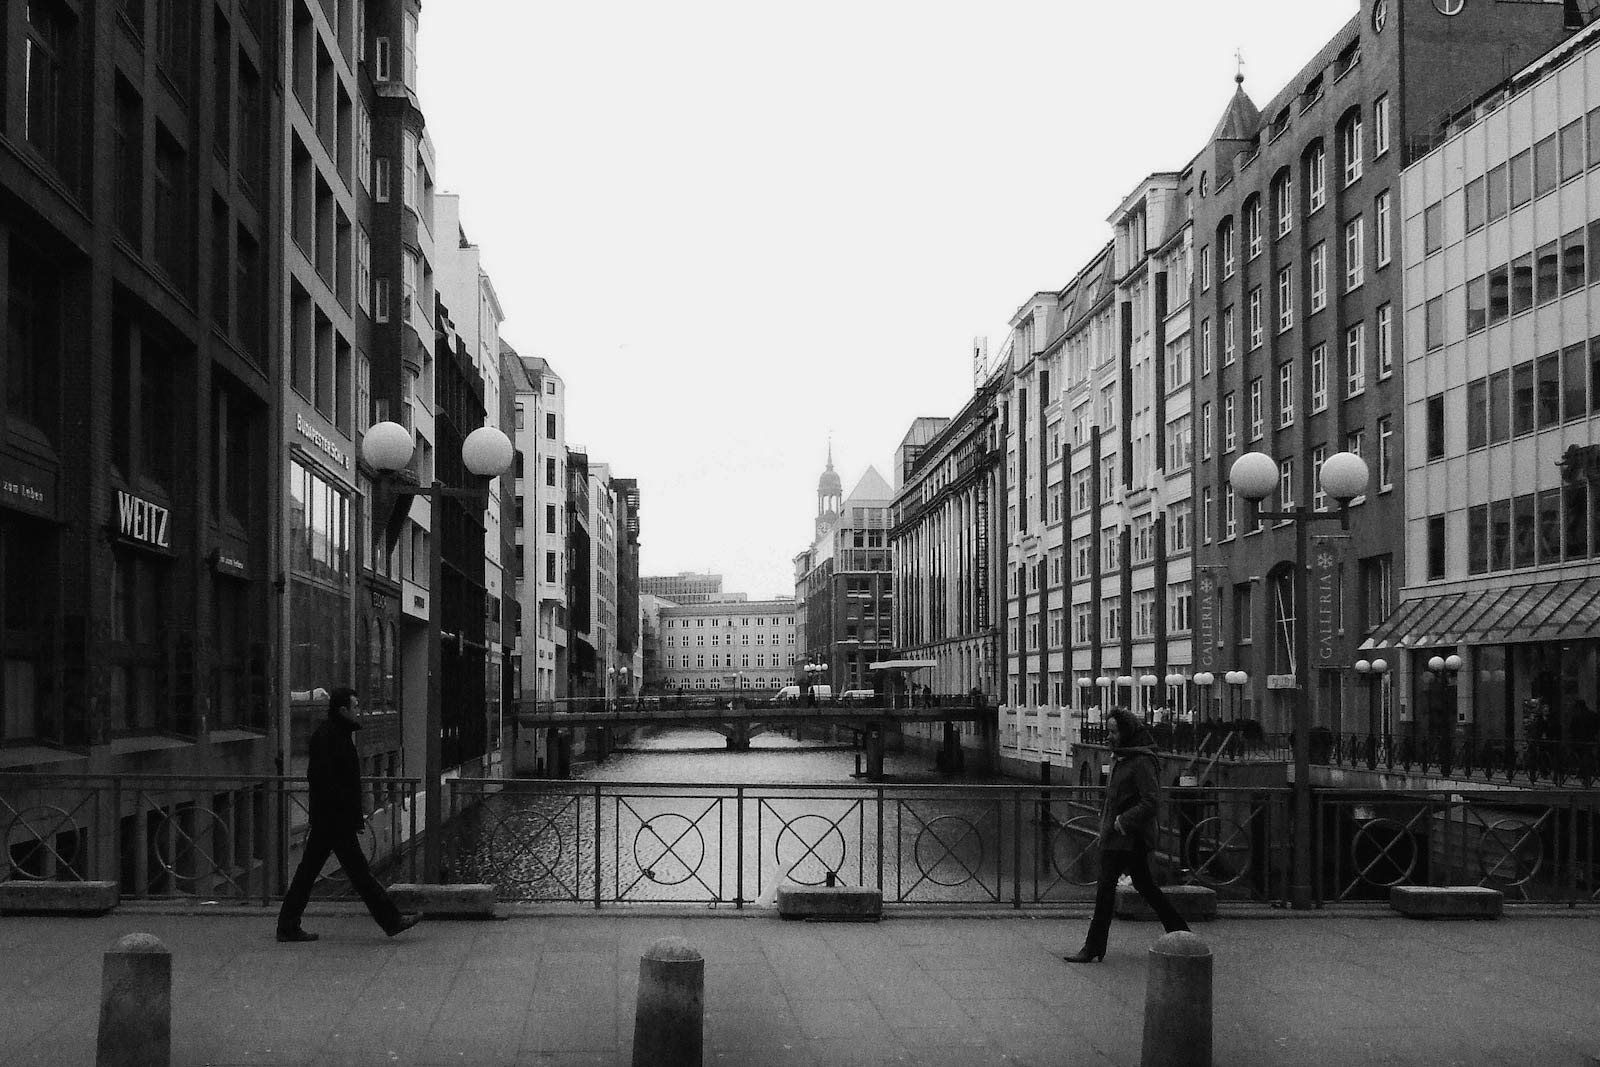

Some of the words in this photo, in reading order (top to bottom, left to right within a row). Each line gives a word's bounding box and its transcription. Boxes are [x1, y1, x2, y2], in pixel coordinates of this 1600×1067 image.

[117, 490, 169, 548] WEITZ
[1201, 595, 1213, 666] GALLERIA
[1319, 574, 1333, 659] GALLERIA
